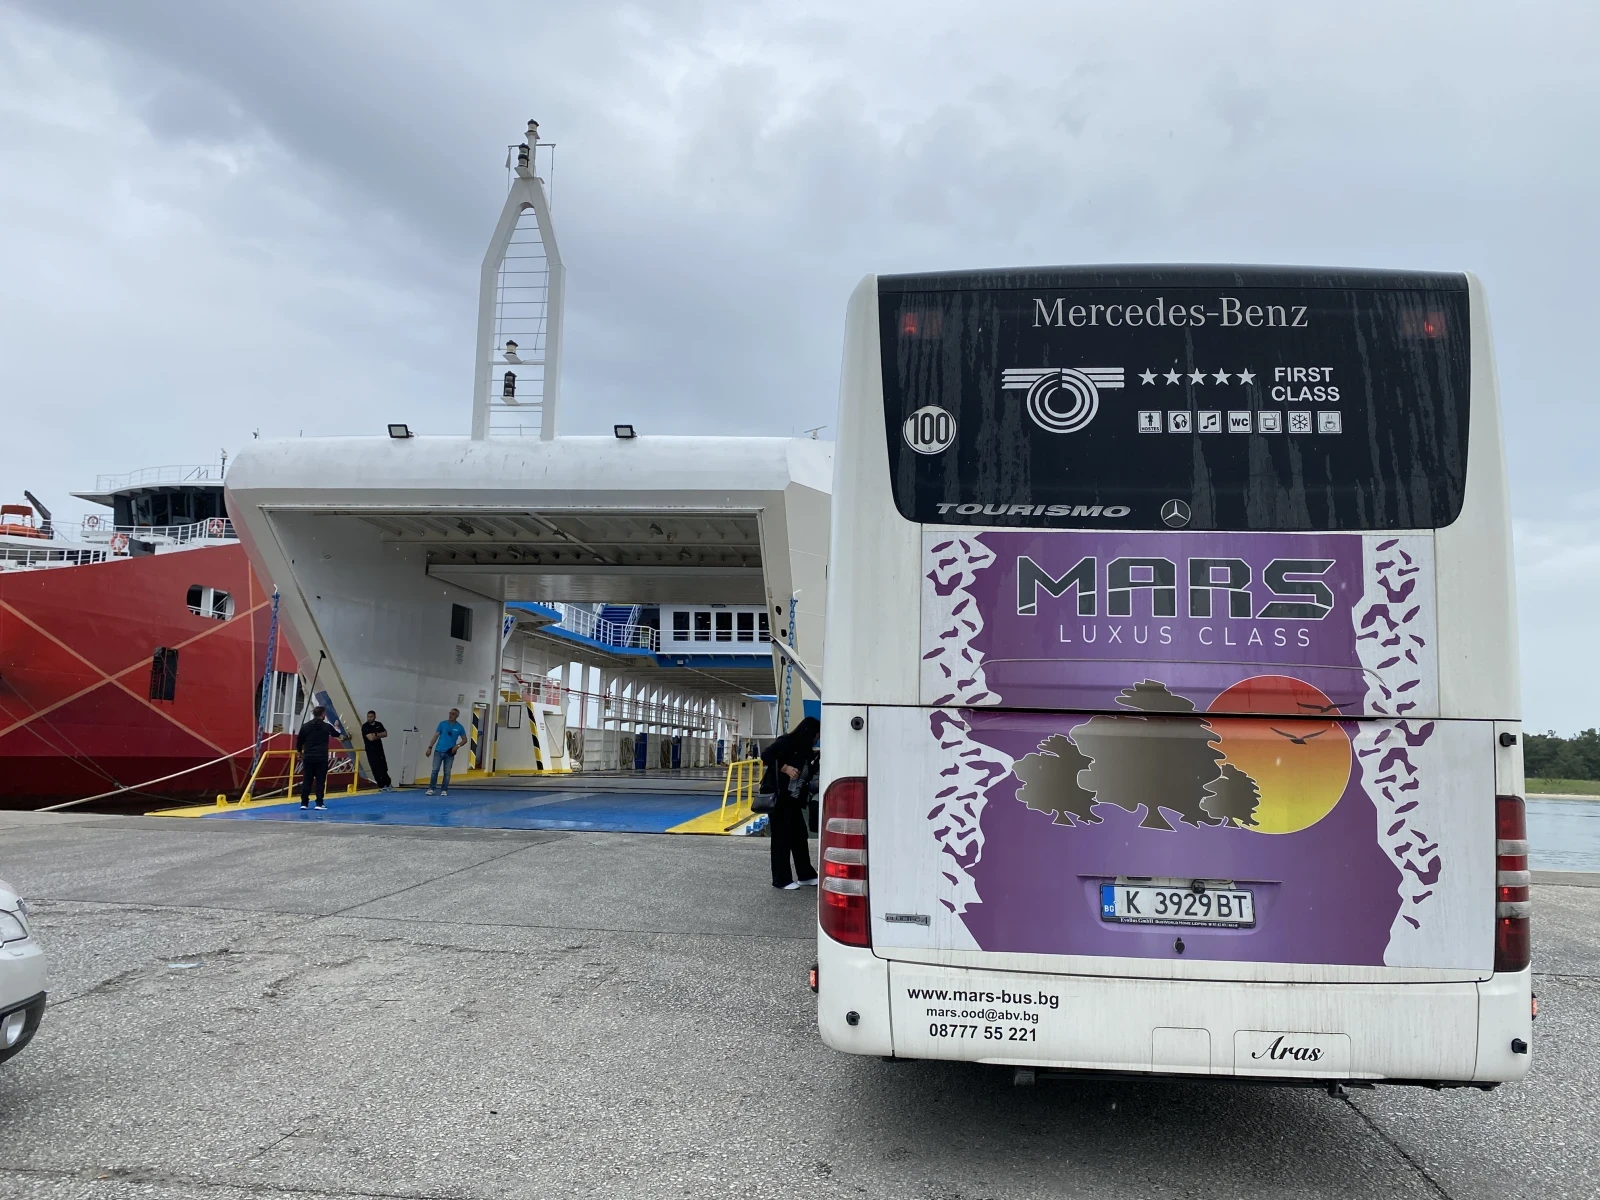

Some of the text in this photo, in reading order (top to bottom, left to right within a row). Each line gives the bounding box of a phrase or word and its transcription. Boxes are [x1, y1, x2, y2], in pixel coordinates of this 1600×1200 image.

[1032, 297, 1309, 328] Mercedes-Benz
[1274, 367, 1334, 383] FIRST
[1271, 386, 1341, 402] CLASS
[909, 412, 950, 445] 100
[1231, 417, 1249, 427] WC
[936, 503, 1131, 518] TOURISMO
[1017, 556, 1336, 620] MARS
[1059, 624, 1311, 647] LUXUS CLASS
[1104, 904, 1115, 913] BG
[1126, 890, 1141, 914] K
[907, 988, 1060, 1009] www.mars-bus.bg
[926, 1008, 1039, 1024] mars.ood@abv.bg
[929, 1023, 1036, 1042] 08777 55 221
[1251, 1035, 1325, 1061] Aras
